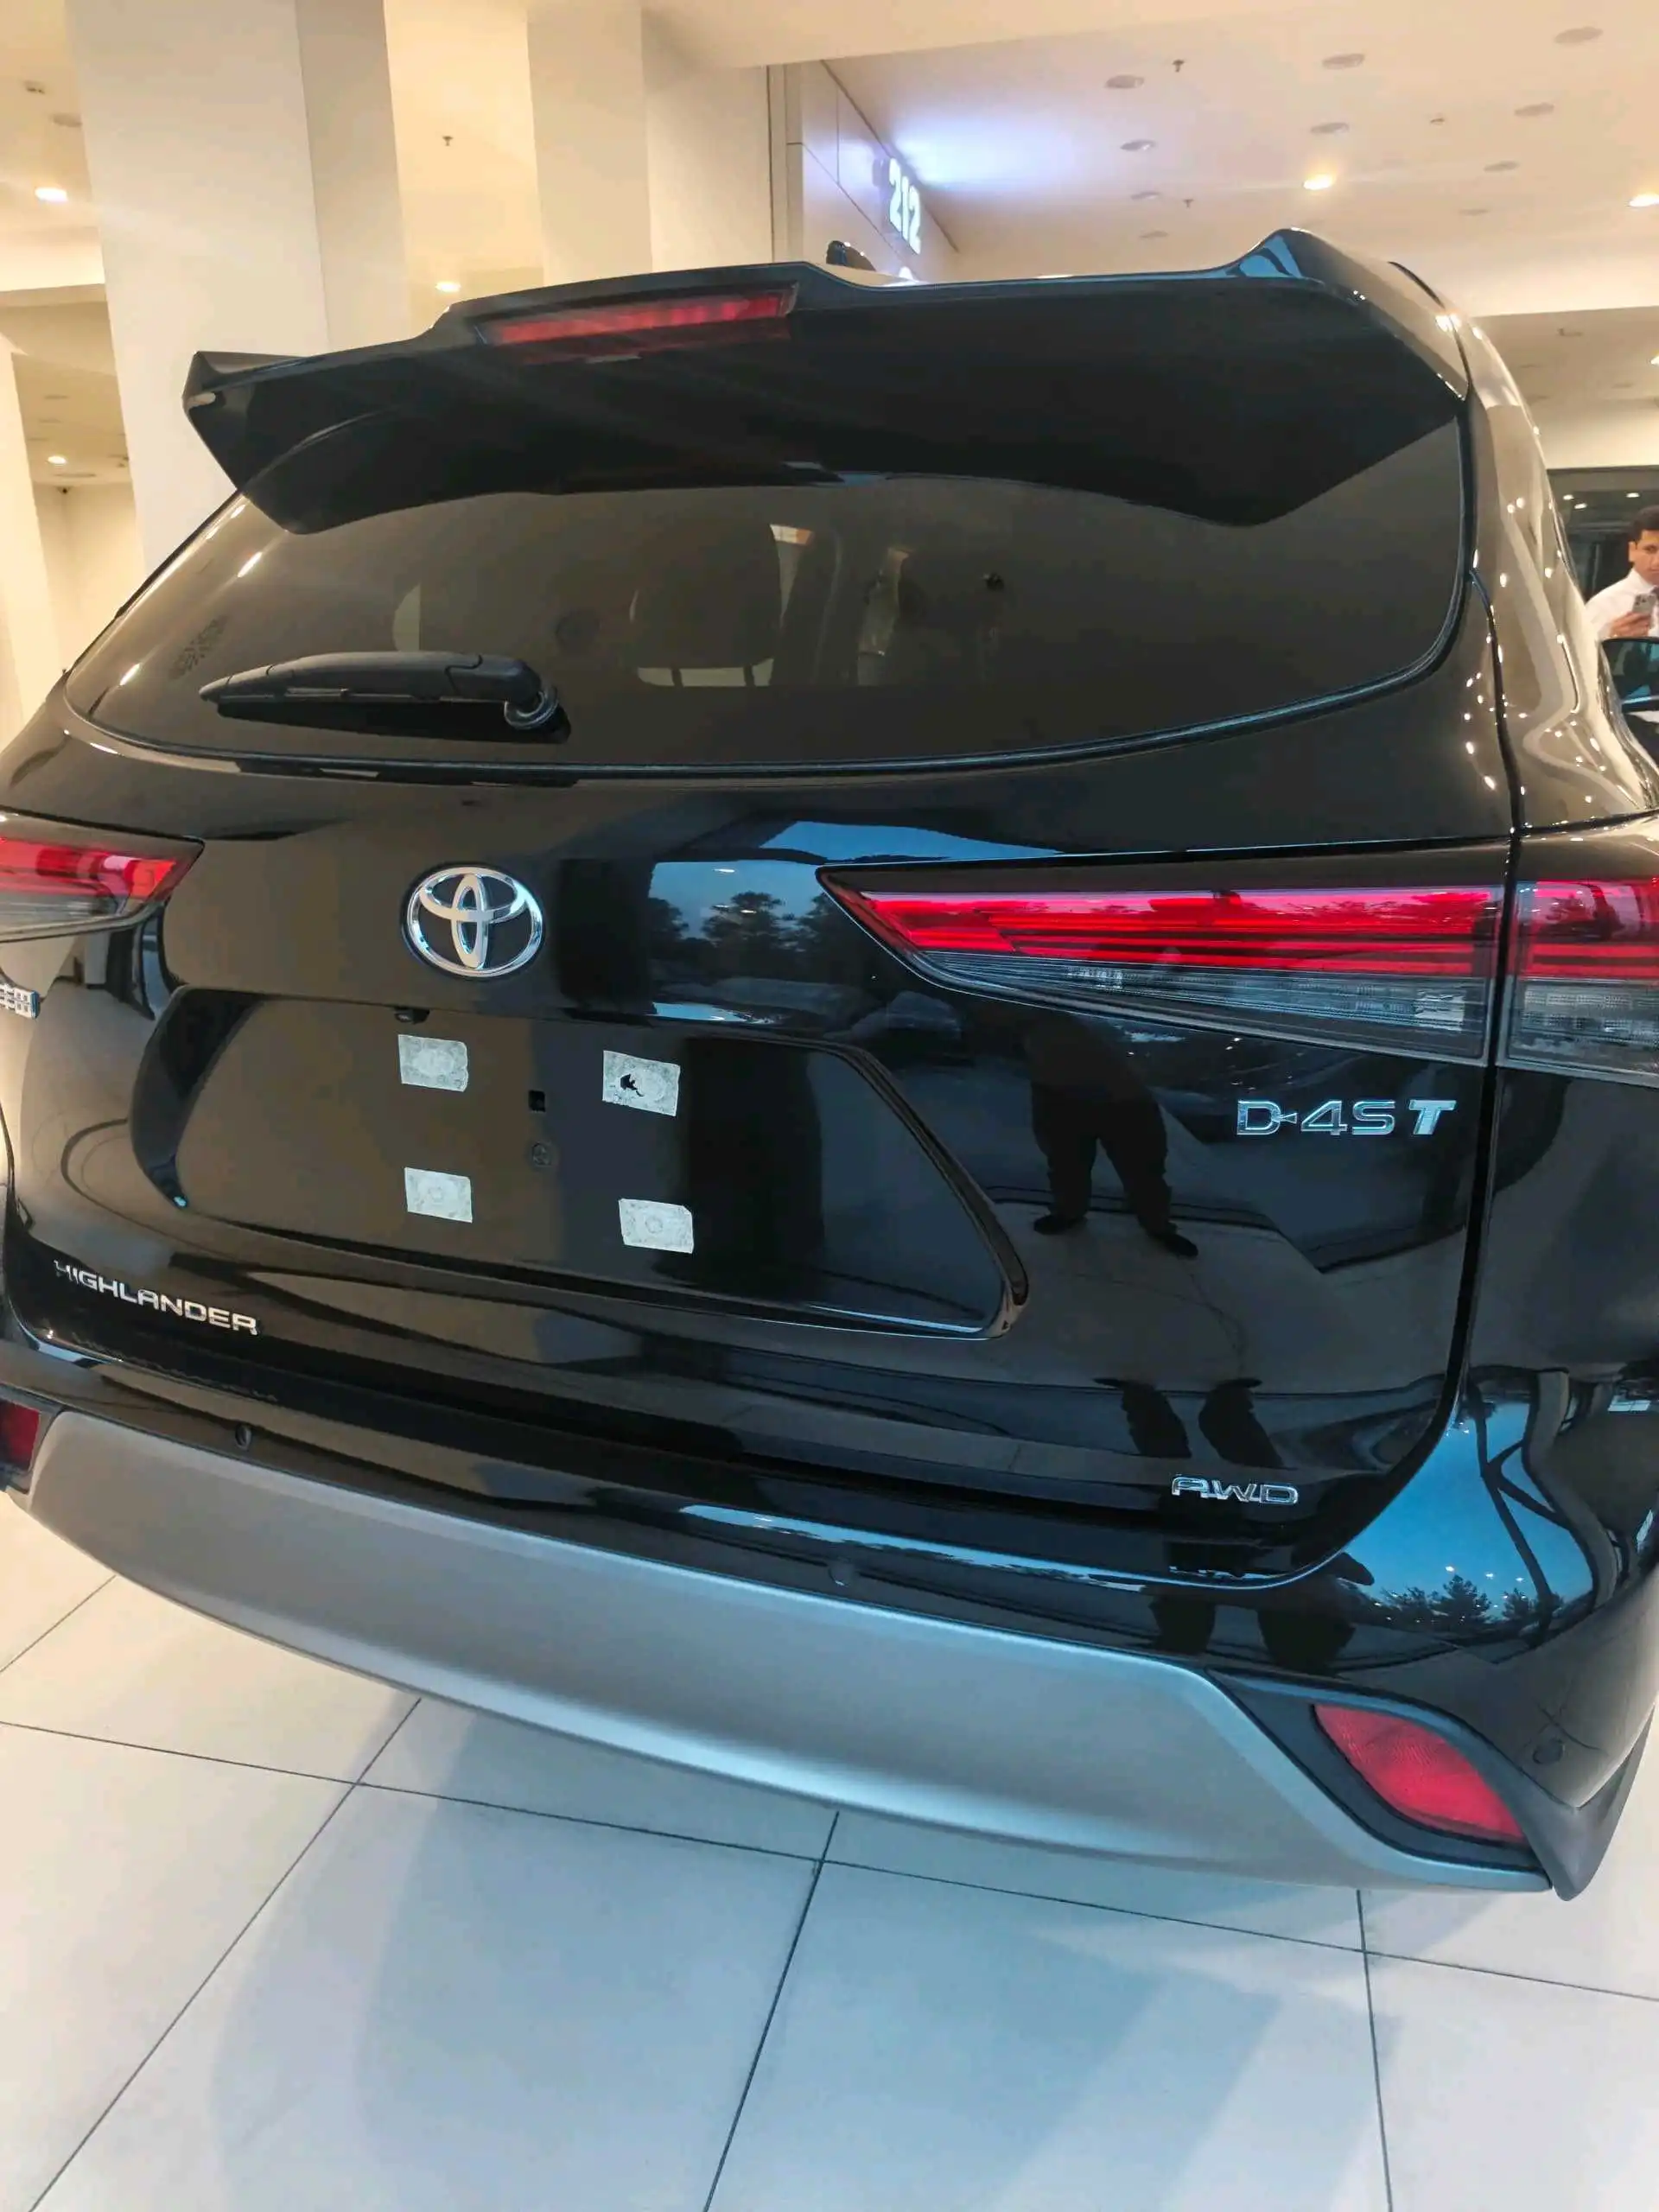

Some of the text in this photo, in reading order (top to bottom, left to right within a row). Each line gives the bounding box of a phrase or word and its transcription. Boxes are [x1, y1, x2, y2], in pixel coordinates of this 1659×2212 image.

[1408, 1099, 1457, 1135] T
[54, 1259, 258, 1336] HIGHLANDER
[1172, 1476, 1299, 1504] AWD
